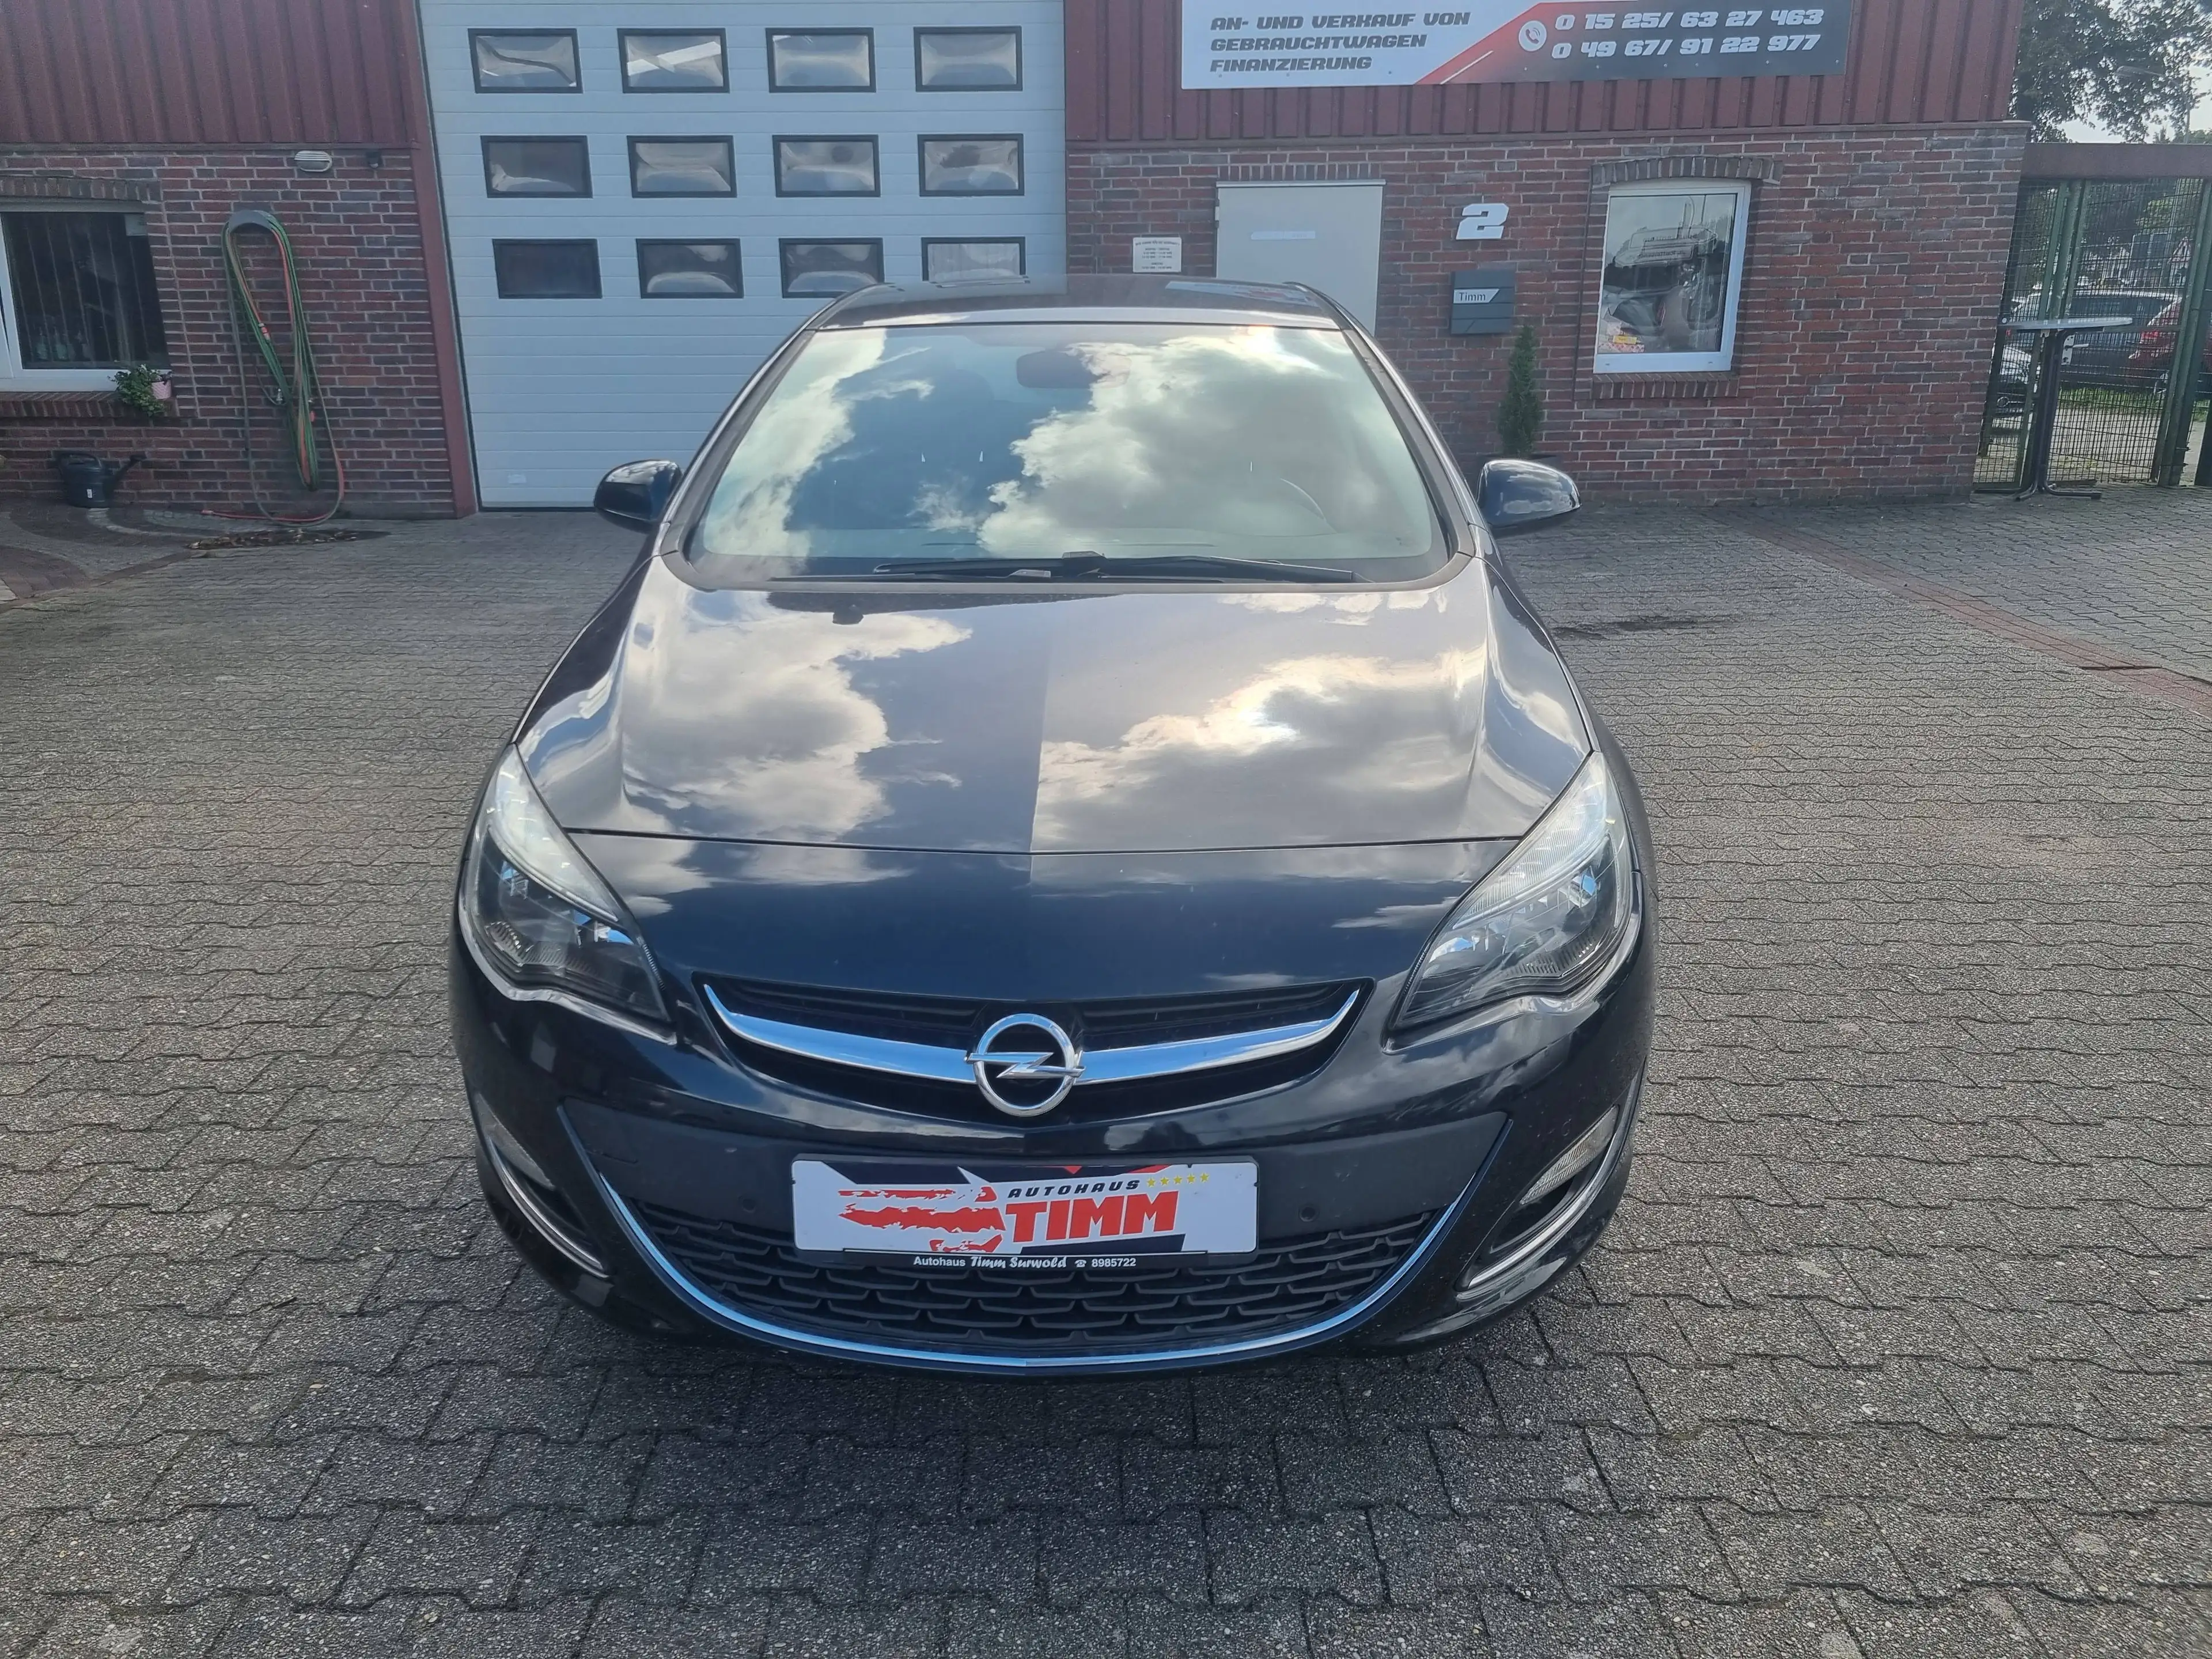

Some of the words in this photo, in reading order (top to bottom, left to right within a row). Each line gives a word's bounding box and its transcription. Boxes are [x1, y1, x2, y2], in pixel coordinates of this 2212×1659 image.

[1210, 17, 1249, 30] AN-
[1256, 16, 1304, 29] UND
[1312, 13, 1416, 28] VERKAUF
[1423, 12, 1471, 26] VON
[1555, 14, 1575, 30] 0
[1585, 14, 1615, 29] 15
[1622, 12, 1674, 29] 25/
[1680, 11, 1718, 28] 63
[1725, 10, 1762, 27] 27
[1770, 9, 1824, 26] 463
[1210, 35, 1427, 51] GEBRAUCHTWAGEN
[1551, 43, 1571, 59] 0
[1581, 41, 1617, 58] 49
[1624, 39, 1673, 56] 67/
[1679, 38, 1714, 55] 91
[1719, 36, 1760, 54] 22
[1767, 35, 1821, 51] 977
[1210, 56, 1372, 72] FINANZIERUNG
[1456, 203, 1509, 240] 2
[1459, 292, 1486, 301] Timm
[1007, 1180, 1140, 1198] AUTOHAUS
[1005, 1191, 1179, 1243] TIMM
[913, 1256, 966, 1266] Autohaus
[970, 1256, 1006, 1268] Timm
[1009, 1256, 1067, 1268] Surwold
[1092, 1257, 1136, 1267] 8985722
